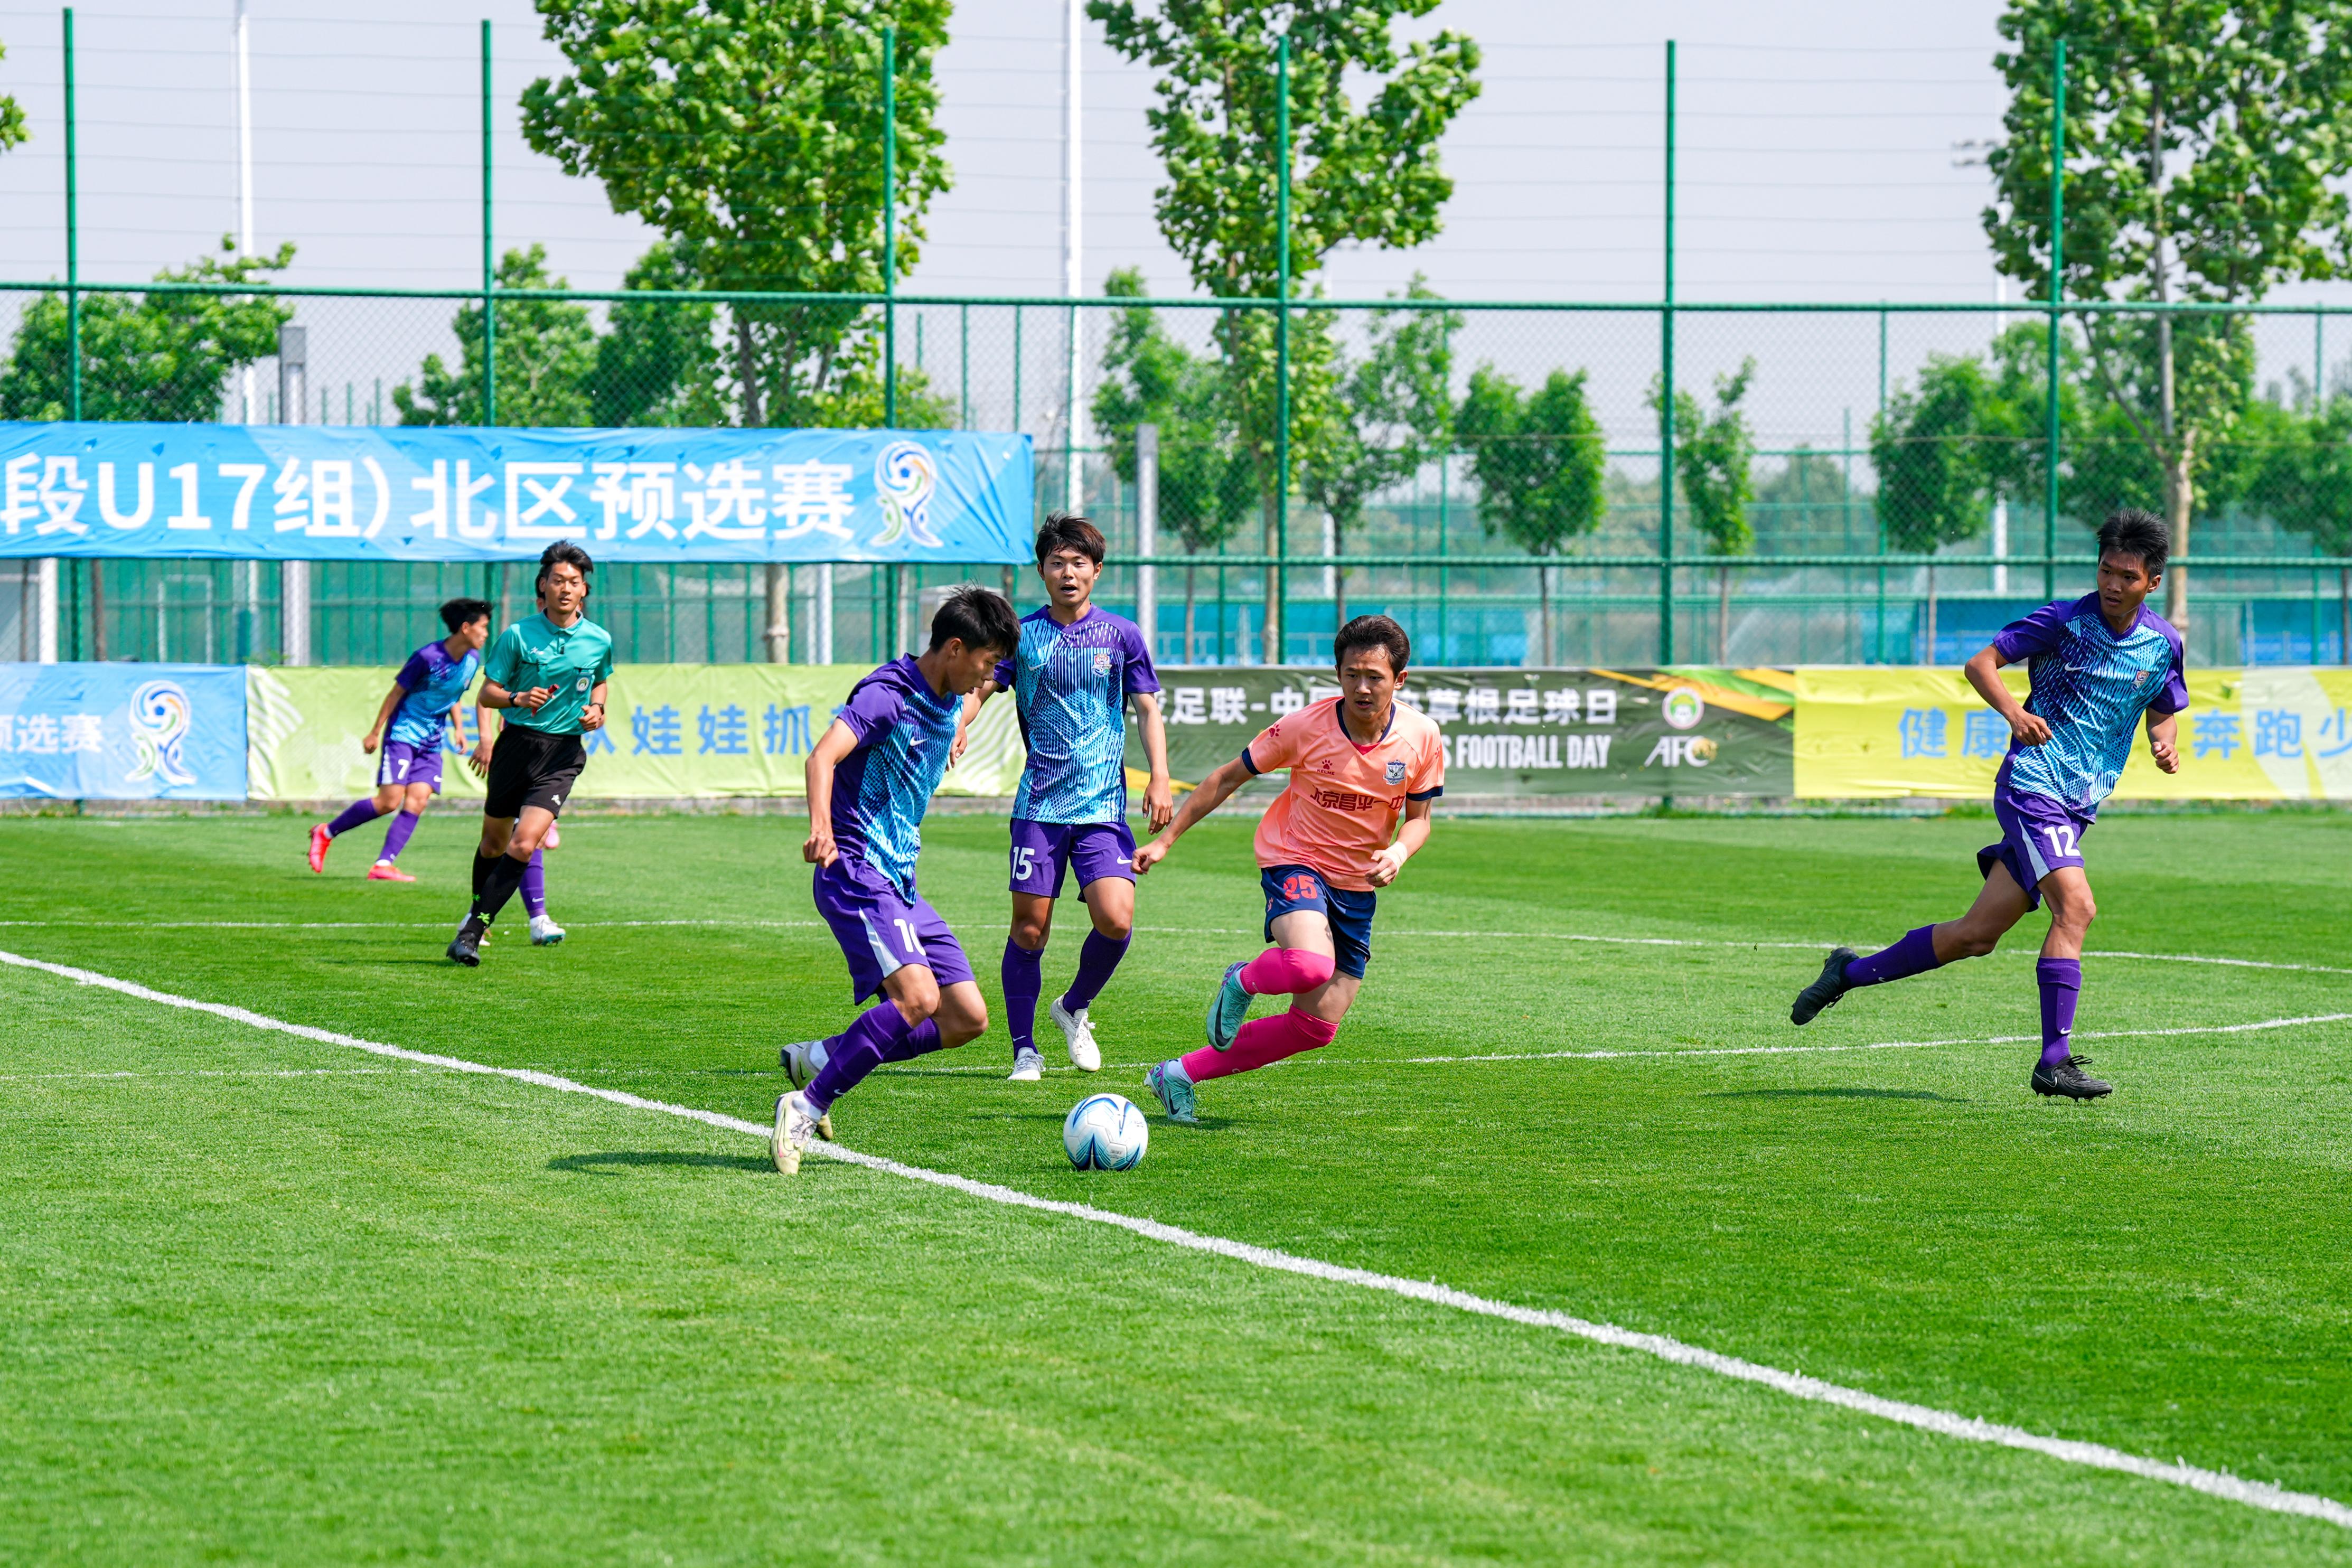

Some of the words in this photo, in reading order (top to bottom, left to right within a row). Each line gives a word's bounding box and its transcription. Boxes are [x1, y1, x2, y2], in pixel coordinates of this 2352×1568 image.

[1456, 734, 1563, 769] FOOTBALL
[1567, 735, 1611, 768] DAY
[1644, 735, 1718, 767] AFC
[397, 758, 410, 780] 7
[2044, 826, 2081, 857] 12
[1012, 846, 1035, 880] 15
[1283, 875, 1318, 901] 25
